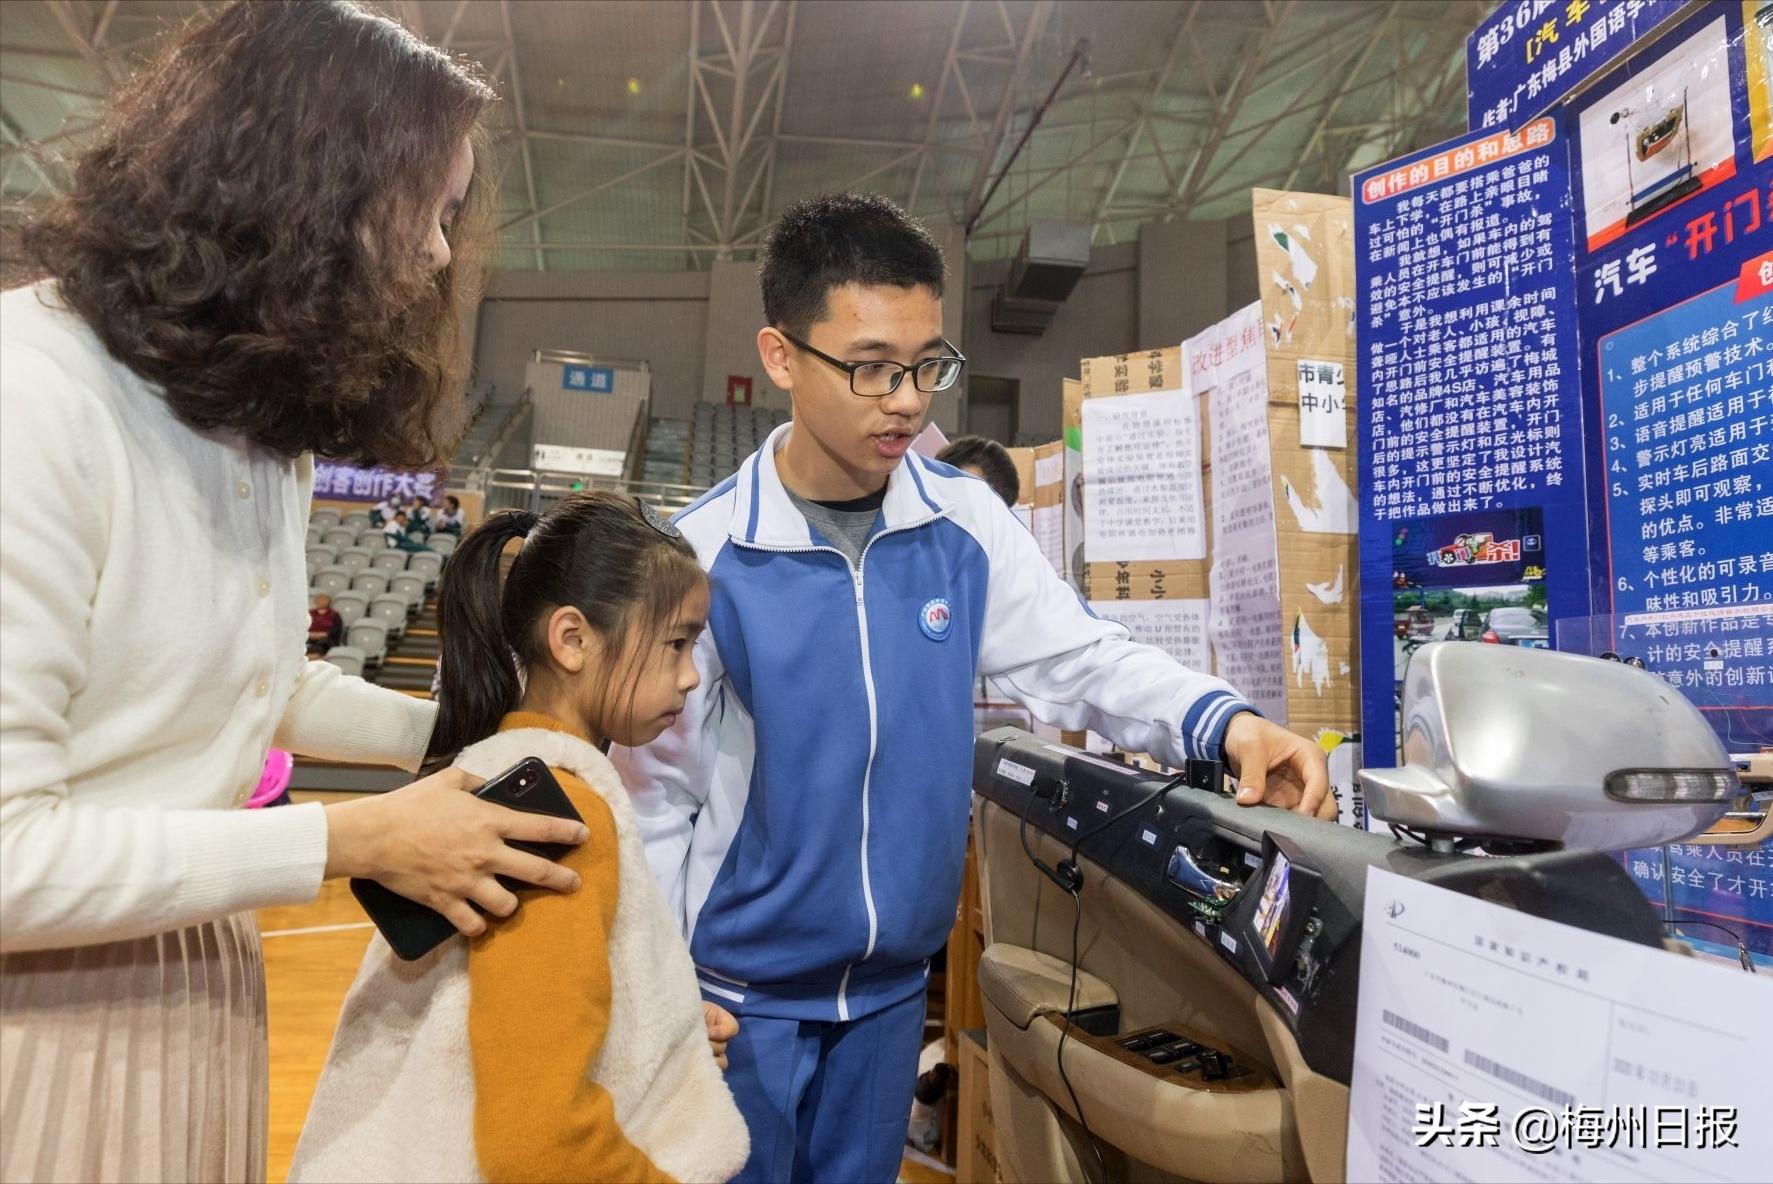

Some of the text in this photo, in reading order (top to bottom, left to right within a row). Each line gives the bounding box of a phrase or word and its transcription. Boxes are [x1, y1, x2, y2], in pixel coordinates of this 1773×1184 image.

[1482, 0, 1658, 128] 作者:广东梅县外国语学
[1367, 123, 1550, 198] 创作的目的和思路
[1594, 179, 1773, 304] 汽车 “开门
[569, 371, 608, 389] 通道
[1633, 337, 1773, 398] 步提醒预警技术。
[1635, 385, 1773, 444] 语音提醒适用于
[1636, 414, 1773, 469] 警示灯亮适用于
[1640, 474, 1762, 516] 探头即可观察，
[1641, 496, 1773, 540] 的优点。非常适
[1643, 540, 1706, 564] 等乘客。
[1644, 552, 1773, 589] 个性化的可录音
[1646, 583, 1772, 612] 味性和吸引力。
[1650, 665, 1773, 688] 意外的创新
[1633, 860, 1773, 899] 确认安全了才开
